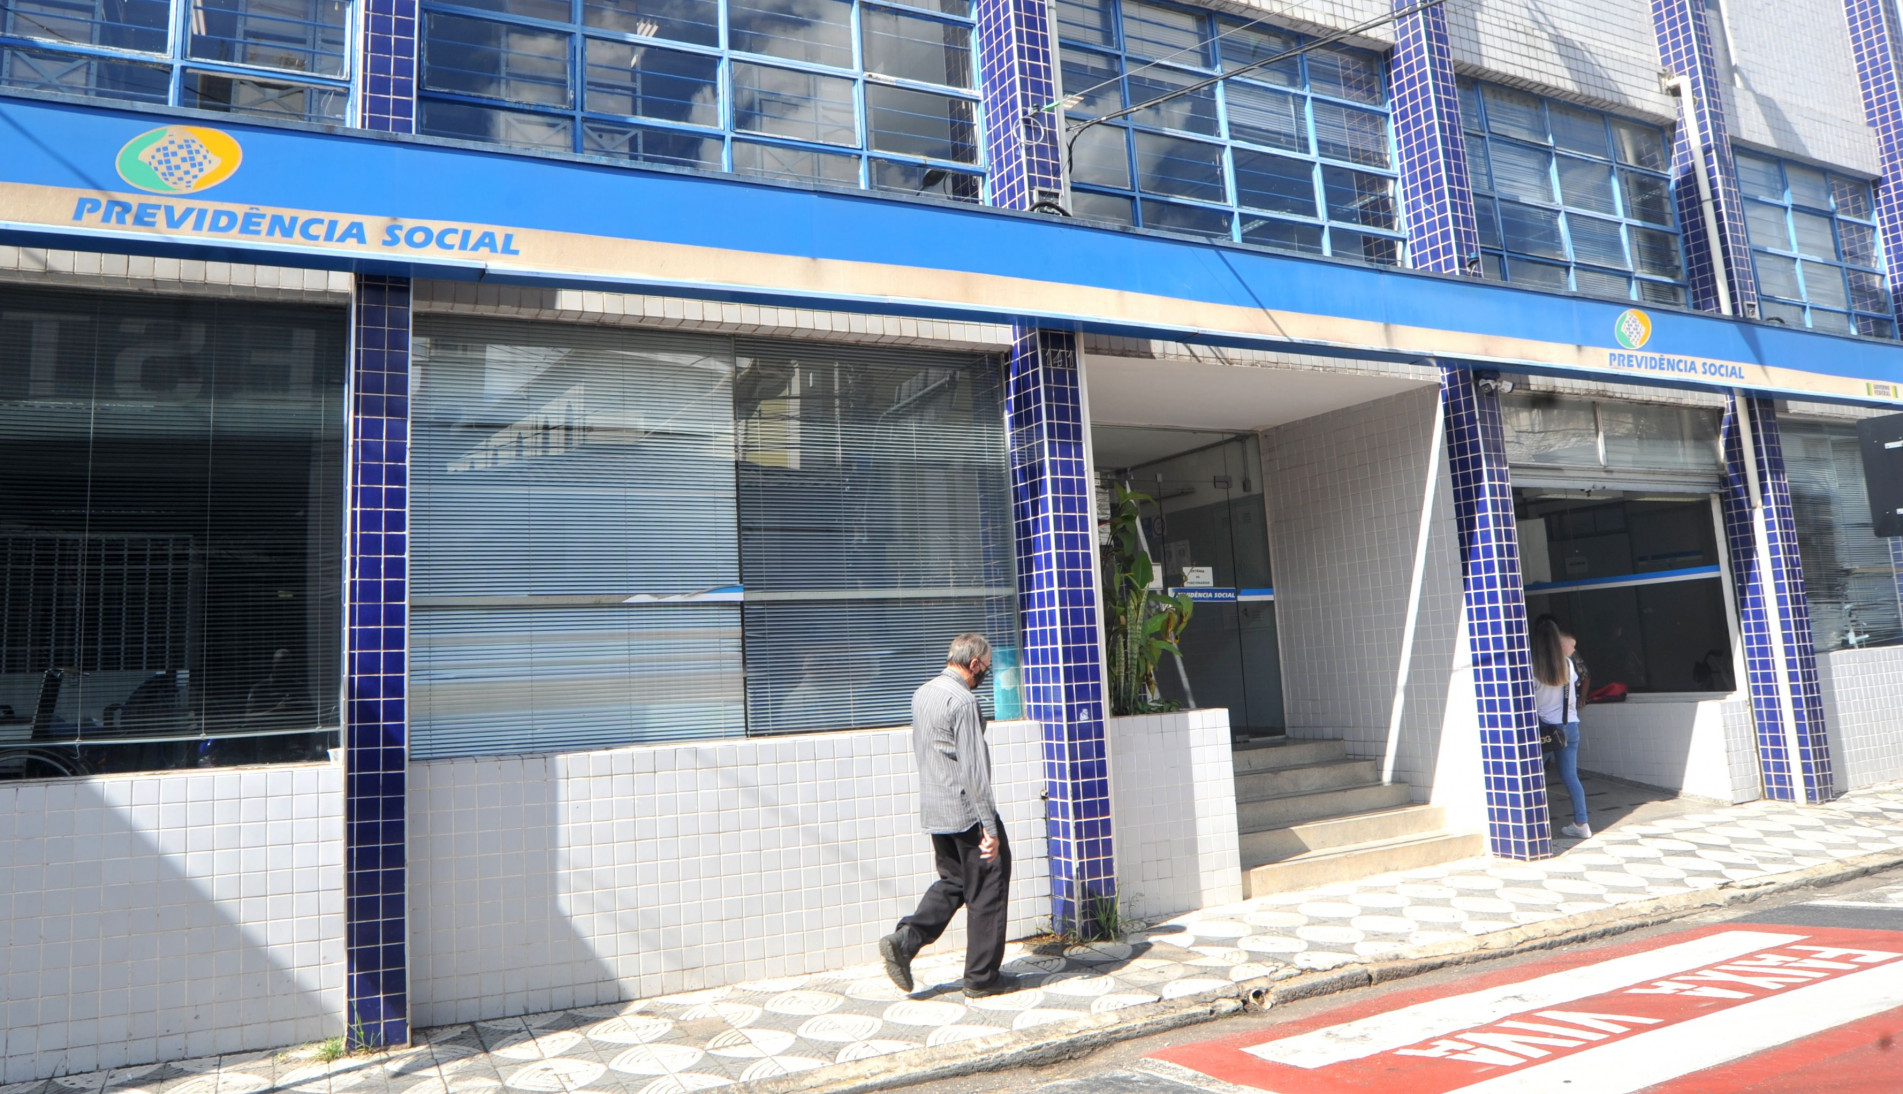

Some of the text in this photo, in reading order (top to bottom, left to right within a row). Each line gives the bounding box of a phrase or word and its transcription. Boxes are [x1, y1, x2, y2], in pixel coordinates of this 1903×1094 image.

[72, 197, 520, 256] PREVIDÊNCIA SOCIAL
[1045, 348, 1074, 367] 141
[1609, 352, 1745, 379] PREVIDÊNCIA SOCIAL
[1391, 944, 1903, 1067] FAIXA VIVA
